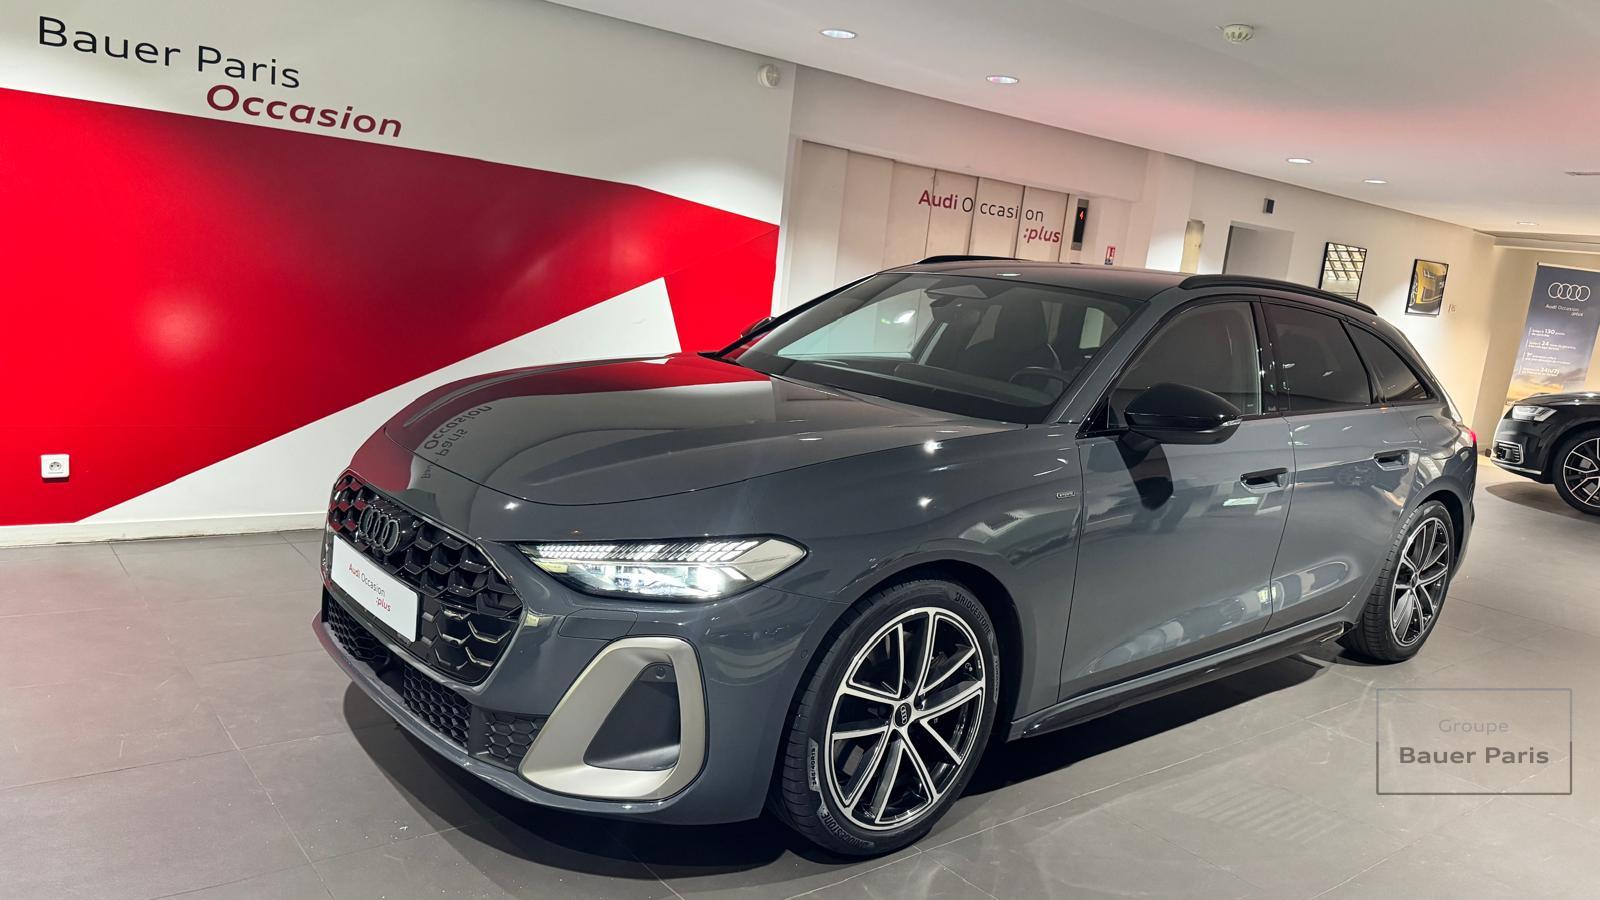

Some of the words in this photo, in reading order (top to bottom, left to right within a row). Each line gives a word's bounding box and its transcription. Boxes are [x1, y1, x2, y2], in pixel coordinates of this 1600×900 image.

[38, 15, 181, 67] Bauer
[197, 45, 300, 88] Paris
[206, 84, 402, 138] Occasion
[918, 189, 958, 210] Audi
[1023, 226, 1061, 244] :plus
[348, 563, 361, 579] Audi
[361, 572, 386, 598] Occasion
